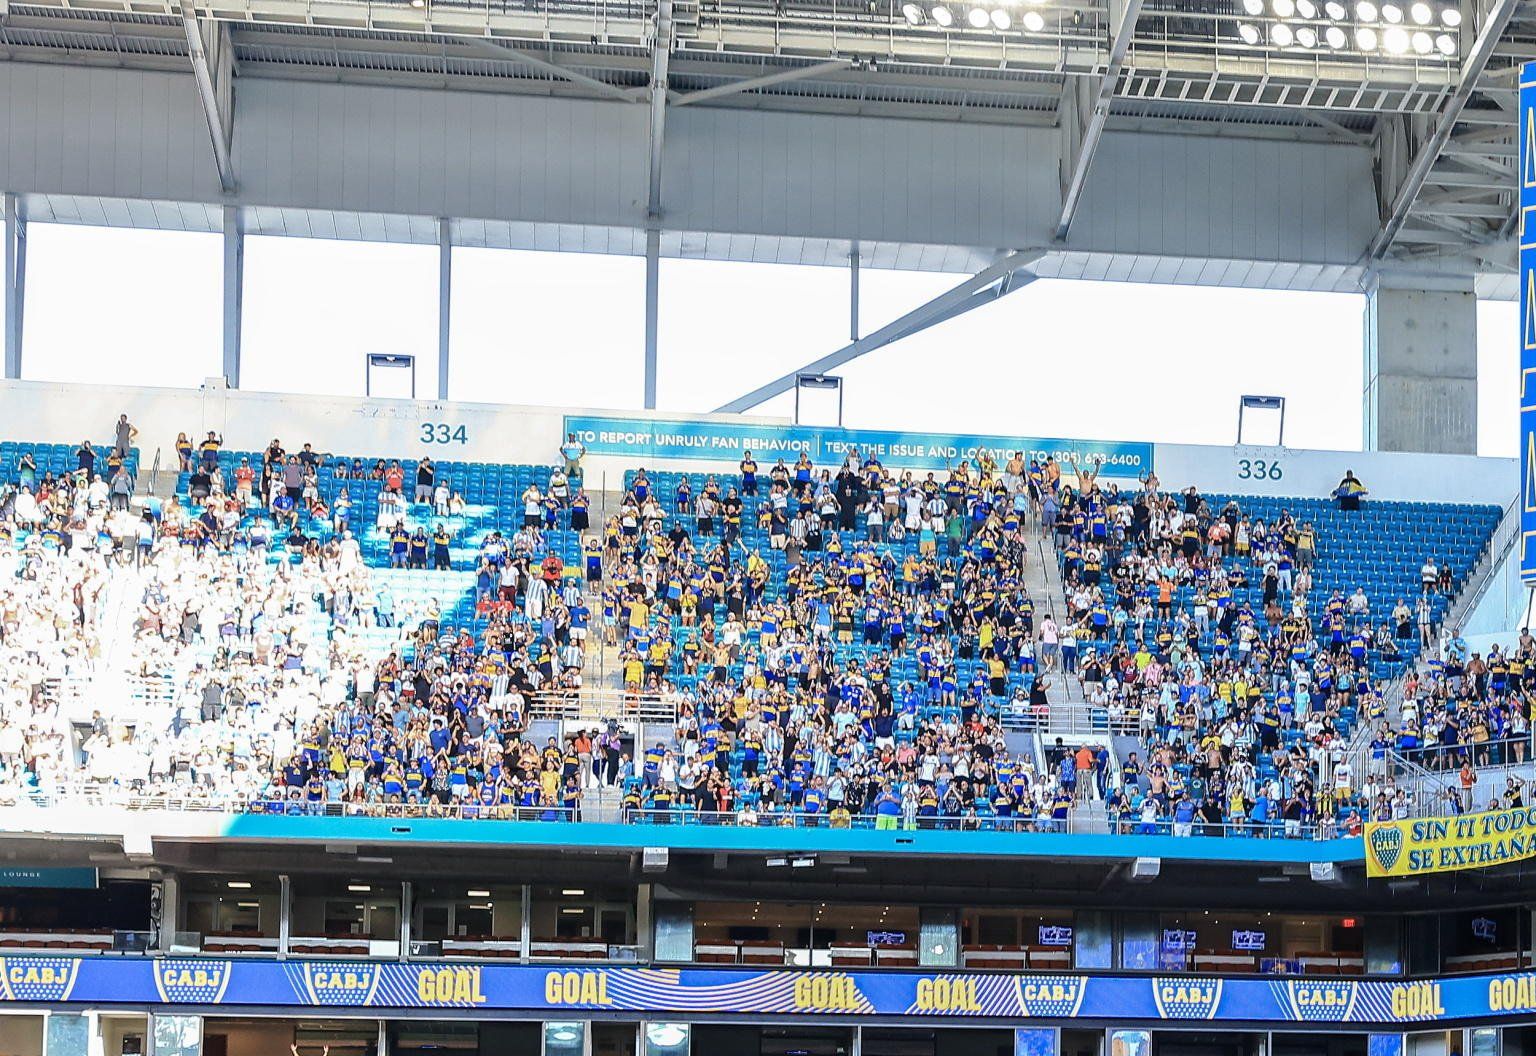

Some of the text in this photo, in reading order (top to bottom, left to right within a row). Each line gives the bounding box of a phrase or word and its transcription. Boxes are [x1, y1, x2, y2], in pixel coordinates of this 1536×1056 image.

[420, 424, 468, 445] 334
[577, 431, 595, 443] TO
[599, 432, 651, 445] REPORT
[656, 434, 708, 448] UNRULY
[712, 436, 739, 449] FAN
[743, 438, 810, 451] BEHAVIOR
[825, 441, 858, 453] TEXT
[861, 444, 885, 456] THE
[889, 445, 924, 457] ISSUE
[928, 447, 956, 458] AND
[1238, 459, 1283, 481] 336
[1411, 819, 1450, 841] SIN
[1455, 818, 1475, 838] TI
[1376, 840, 1399, 851] CABJ
[1409, 849, 1434, 870] SE
[10, 967, 68, 984] CABJ
[164, 970, 221, 986] CABJ
[315, 973, 371, 990] CABJ
[418, 967, 486, 1002] GOAL
[545, 971, 612, 1005] GOAL
[795, 975, 860, 1009] GOAL
[916, 977, 981, 1011] GOAL
[1024, 985, 1077, 1001] CABJ
[1162, 986, 1214, 1004] CABJ
[1297, 987, 1348, 1005] CABJ
[1391, 983, 1444, 1018] GOAL
